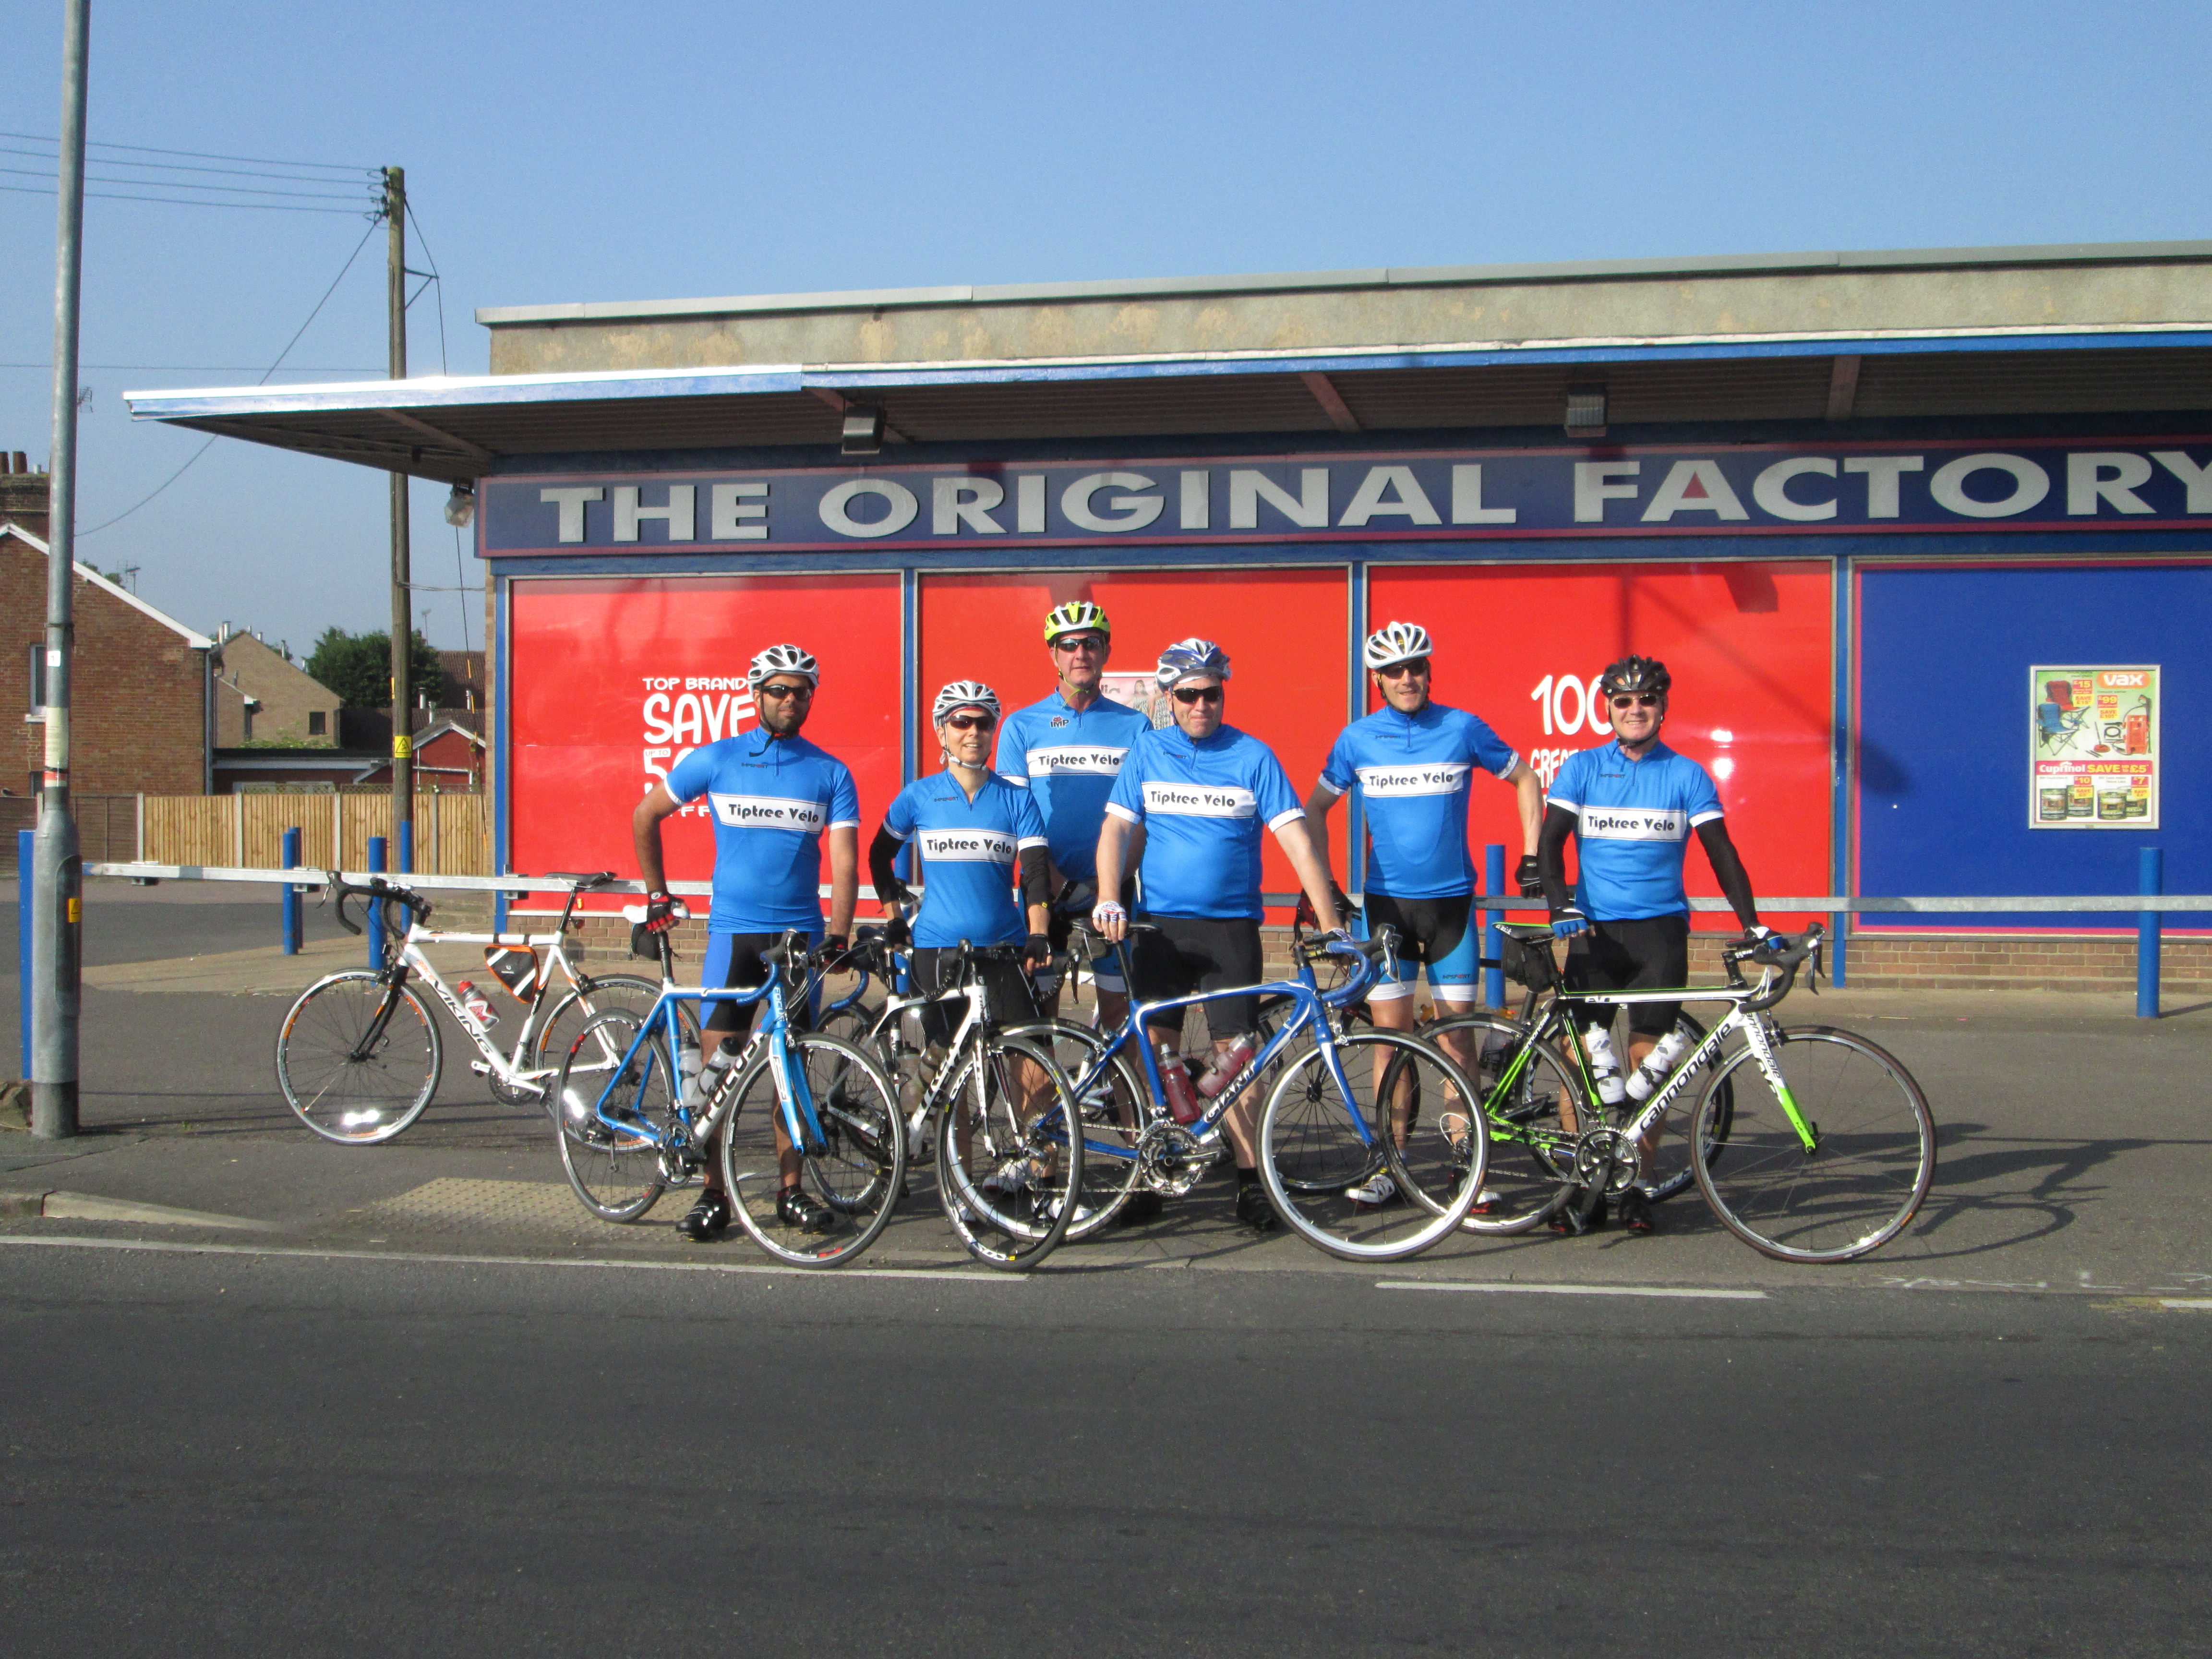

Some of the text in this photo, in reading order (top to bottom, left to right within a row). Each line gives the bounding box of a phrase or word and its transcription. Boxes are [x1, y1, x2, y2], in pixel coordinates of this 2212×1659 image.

[541, 451, 2212, 543] THE ORIGINAL FACTORY
[642, 677, 750, 690] TOP BRAND
[2103, 674, 2144, 686] vax
[643, 693, 756, 744] SAVE
[1050, 719, 1070, 728] IMP
[1038, 754, 1119, 768] Tiptree Vélo
[2040, 763, 2085, 774] Cuprinol
[2087, 764, 2121, 773] SAVE
[1369, 771, 1454, 789] Tiptree Vélo
[1151, 791, 1236, 807] Tiptree Vélo
[729, 804, 784, 819] Tiptree
[789, 807, 819, 823] Vélo
[1588, 816, 1675, 831] Tiptree Vélo
[927, 838, 1012, 854] Tiptree Vélo
[434, 980, 493, 1054] VIKING
[1520, 1011, 1551, 1056] cannondale
[1640, 1023, 1731, 1132] cannondale
